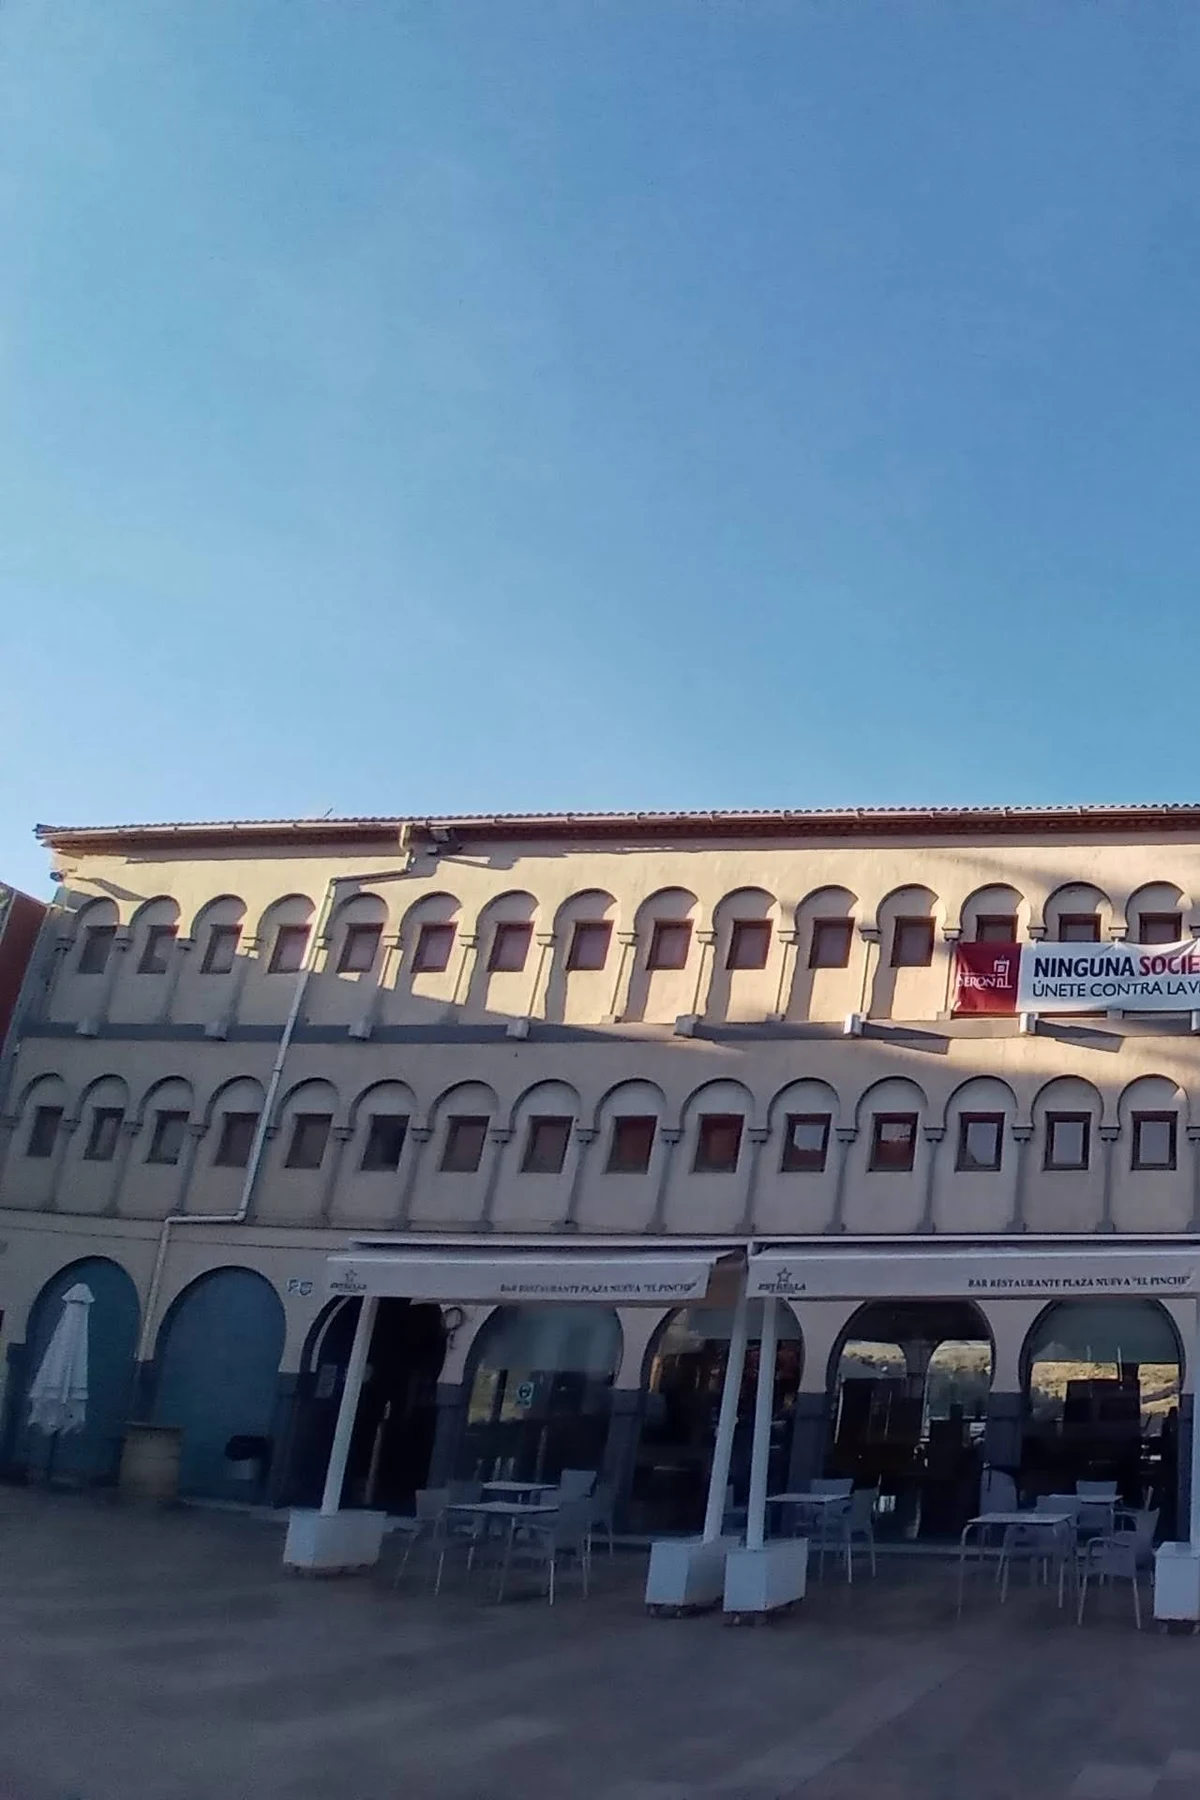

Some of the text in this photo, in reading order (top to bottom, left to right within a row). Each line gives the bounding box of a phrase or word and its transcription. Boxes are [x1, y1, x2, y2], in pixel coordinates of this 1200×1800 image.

[1033, 957, 1135, 978] NINGUNA
[1033, 980, 1086, 997] ÚNETE
[1090, 981, 1163, 997] CONTRA
[968, 1278, 988, 1288] BAR
[990, 1277, 1061, 1288] RESTAURANTE
[1062, 1277, 1095, 1288] PLAZA
[1096, 1276, 1131, 1287] NUEVA
